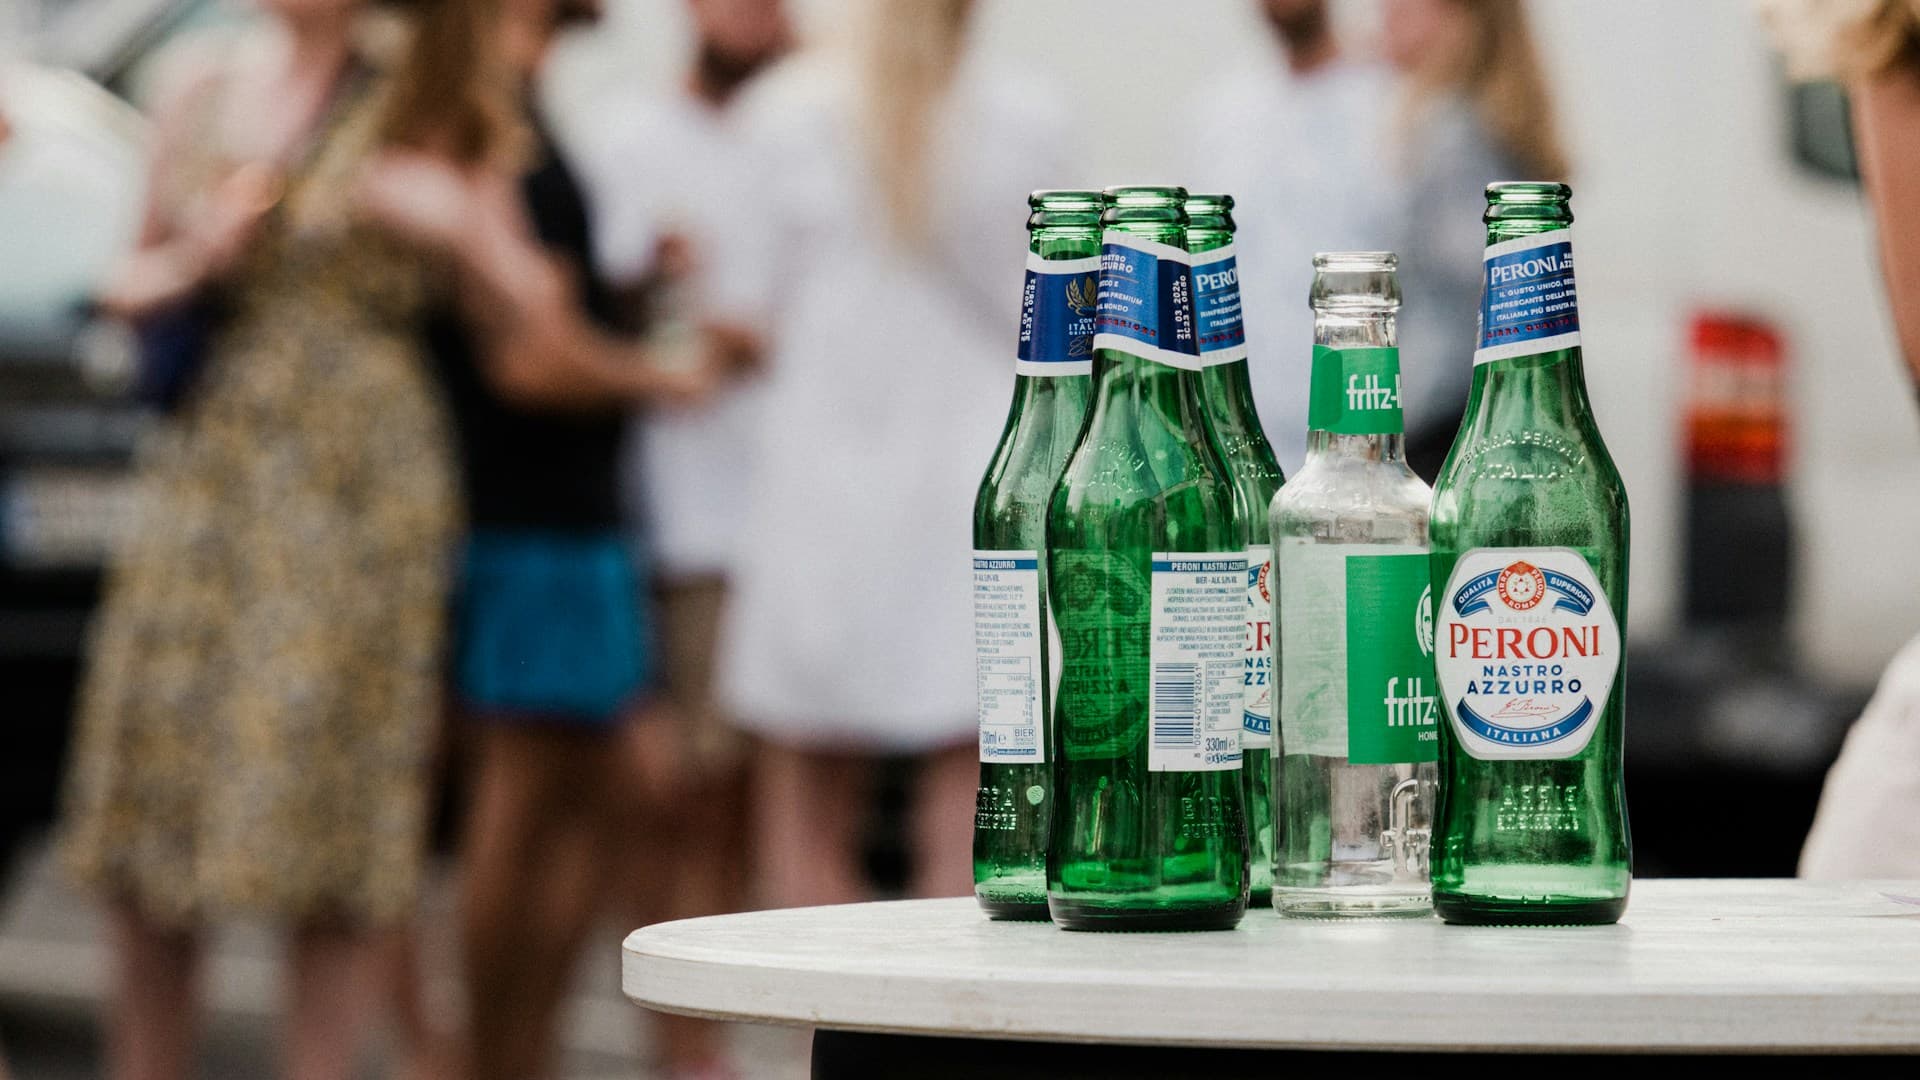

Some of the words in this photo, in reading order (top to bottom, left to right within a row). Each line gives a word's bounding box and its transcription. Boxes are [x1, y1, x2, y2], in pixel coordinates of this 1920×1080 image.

[1491, 255, 1559, 285] PERONI
[1110, 292, 1143, 305] PREMIUM
[1507, 285, 1535, 297] GUSTO
[1496, 309, 1529, 321] ITALIANA
[989, 561, 1016, 569] AZZURRO
[1171, 562, 1200, 571] PERONI
[1202, 562, 1227, 571] NASTRO
[1459, 576, 1494, 604] QUALITÀ
[1499, 569, 1511, 599] BIRRA
[1550, 576, 1592, 606] SUPERIORE
[1449, 623, 1600, 659] PERONI
[1483, 664, 1563, 677] NASTRO
[1466, 679, 1582, 695] AZZURRO
[1014, 728, 1034, 737] BIER
[1486, 727, 1562, 742] ITALIANA
[1205, 736, 1228, 752] 330ml
